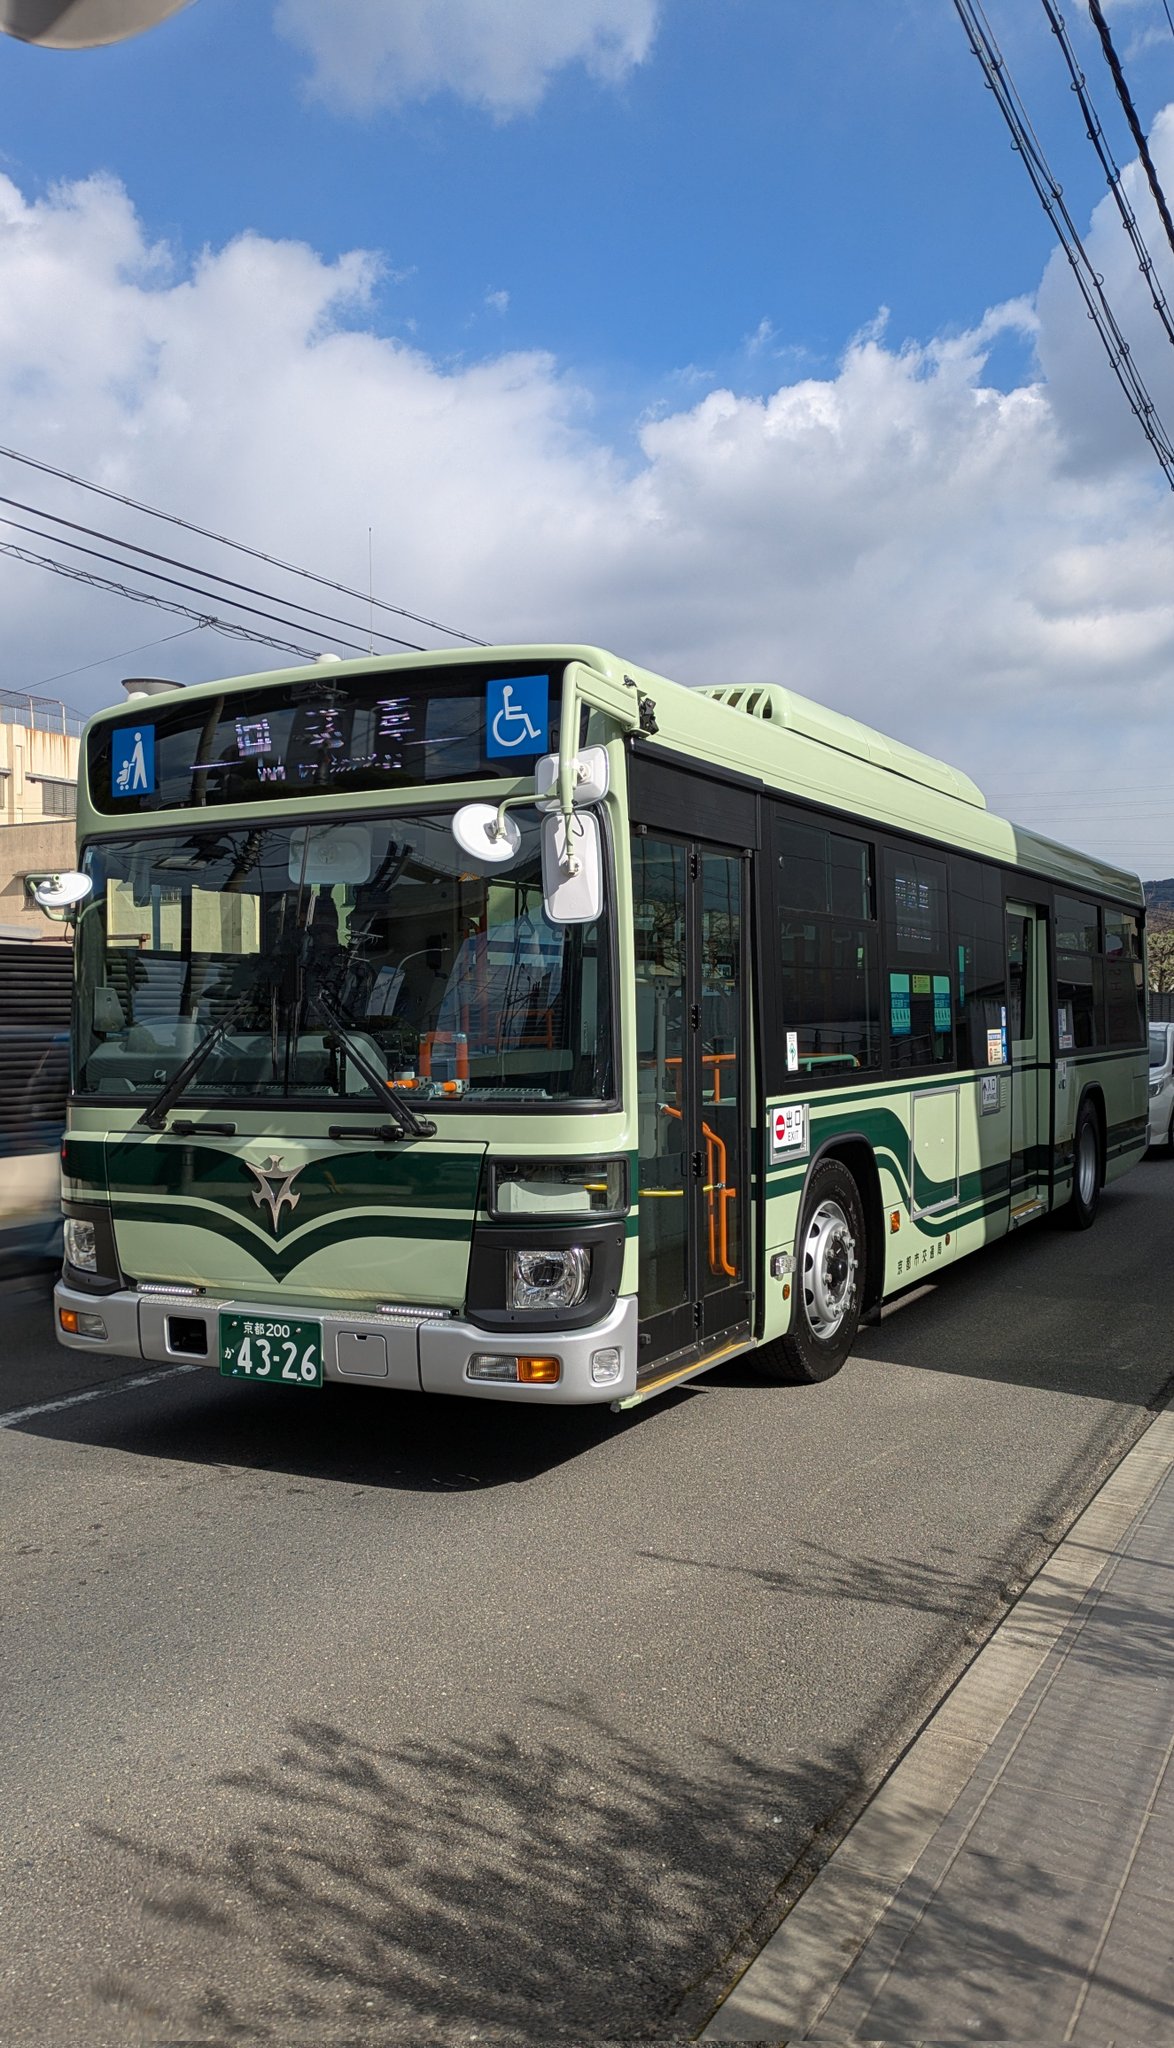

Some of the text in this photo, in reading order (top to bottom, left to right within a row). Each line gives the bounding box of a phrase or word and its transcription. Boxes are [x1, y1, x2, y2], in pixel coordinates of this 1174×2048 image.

[987, 1078, 996, 1092] 入口
[786, 1109, 801, 1129] 出口
[787, 1130, 799, 1142] EXIT
[224, 1337, 315, 1380] か 43-26
